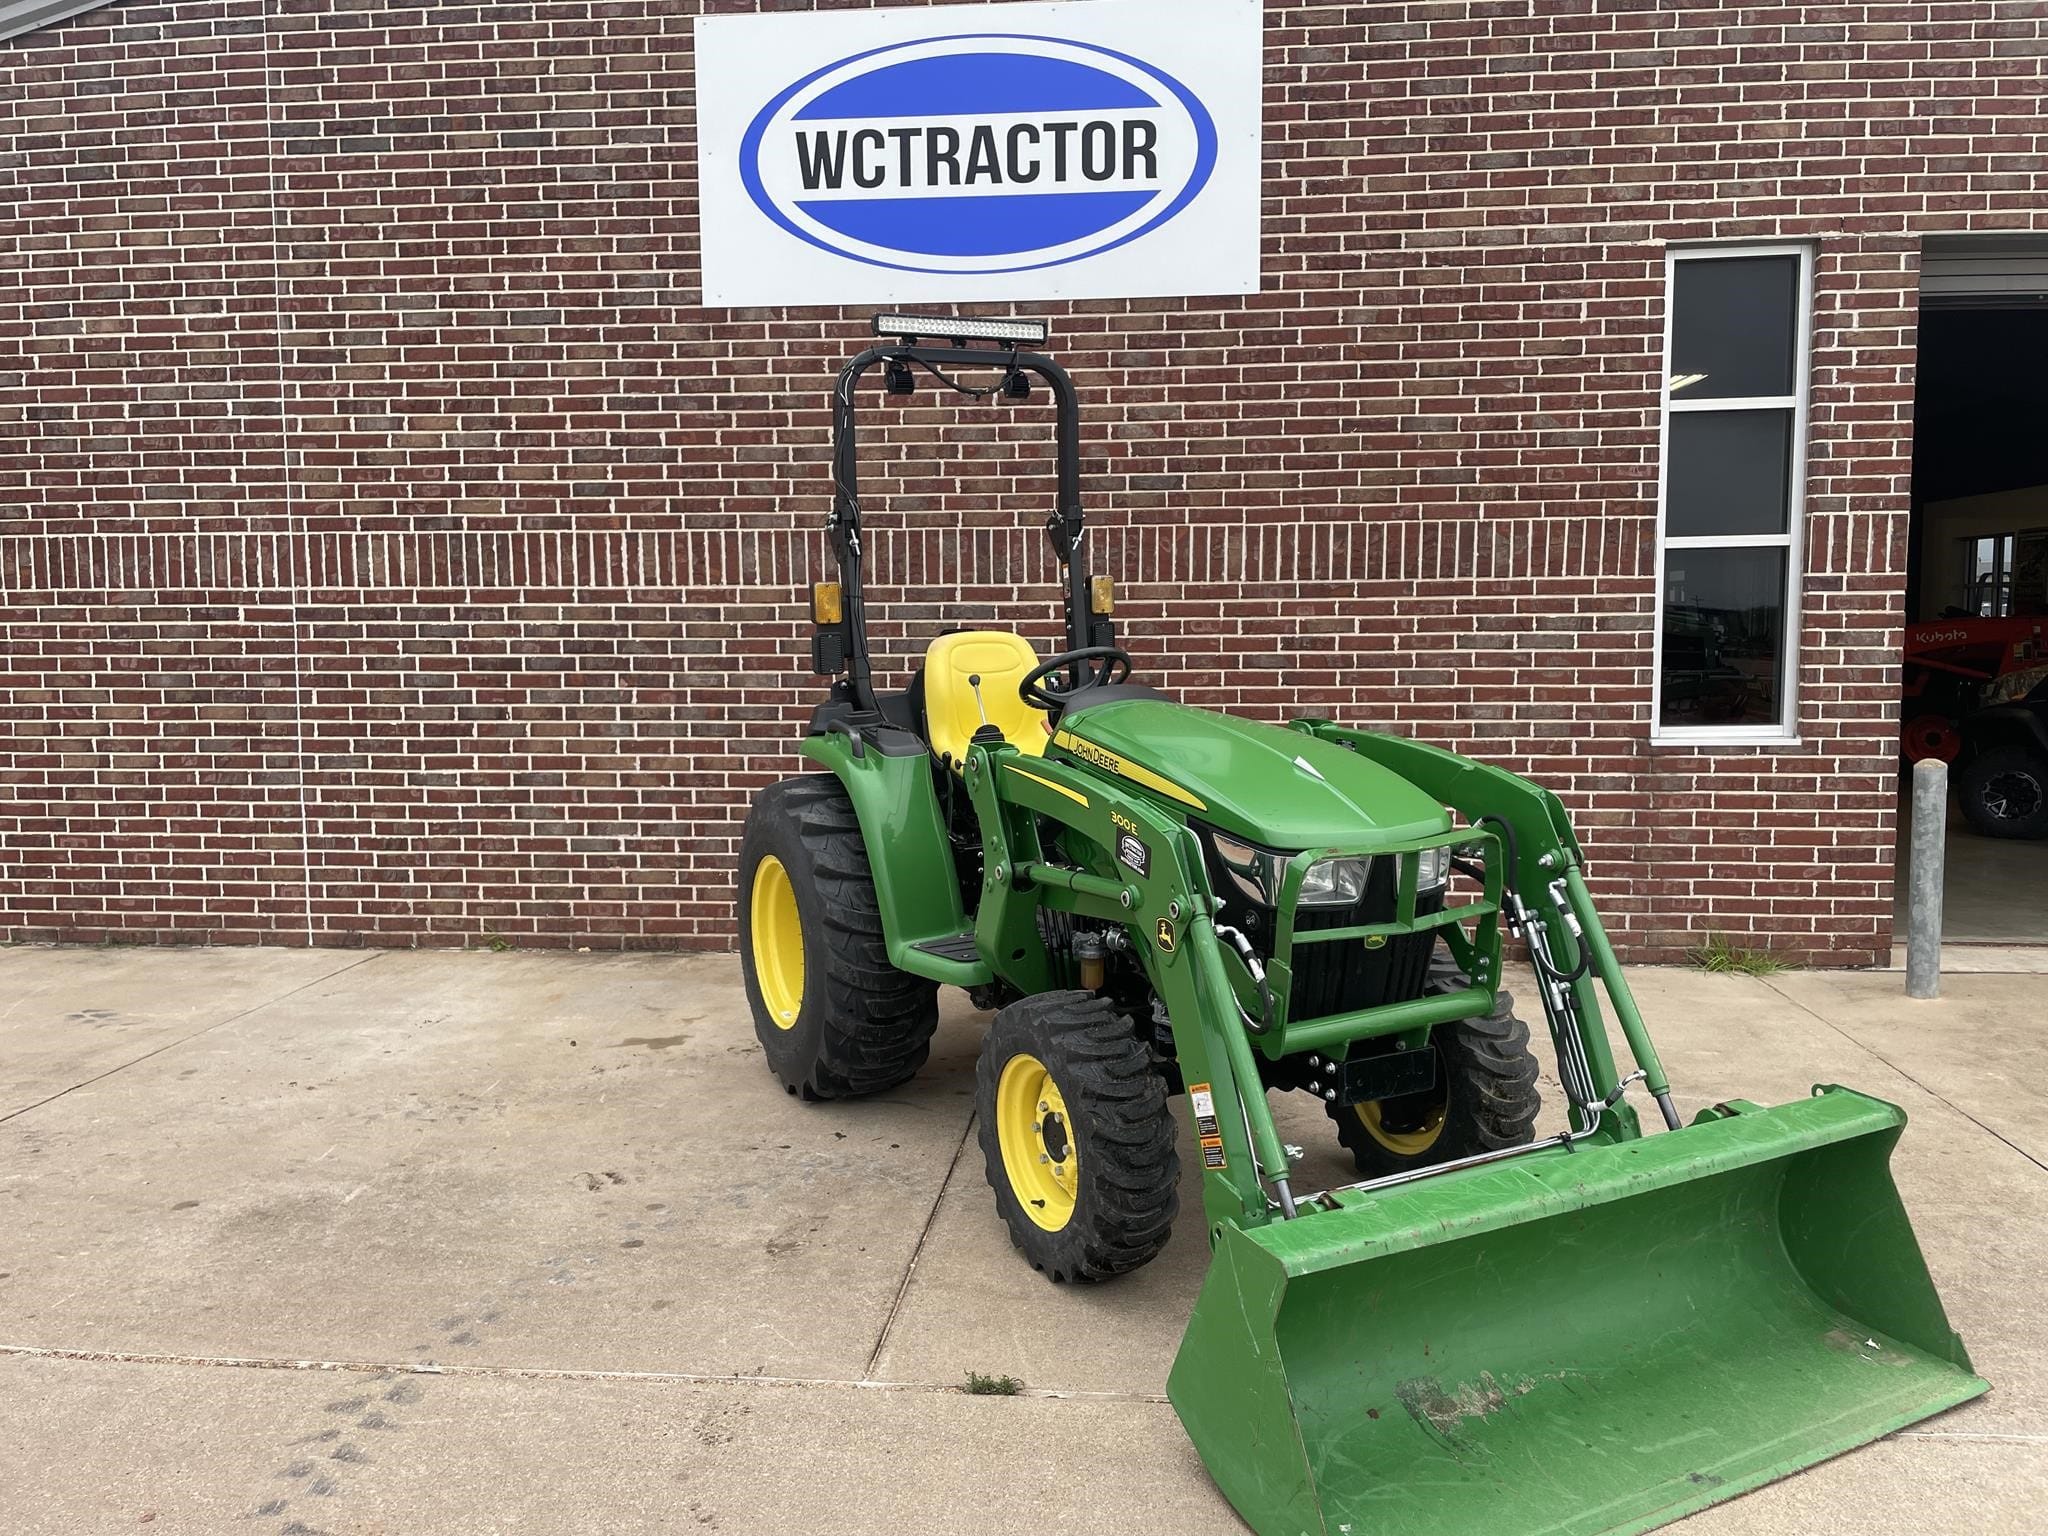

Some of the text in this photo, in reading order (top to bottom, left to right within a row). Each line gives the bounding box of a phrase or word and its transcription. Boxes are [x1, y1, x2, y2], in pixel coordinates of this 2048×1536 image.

[796, 120, 1158, 190] WCTRACTOR
[1916, 629, 1968, 643] Kubota
[1073, 740, 1119, 773] JOHN DEERE
